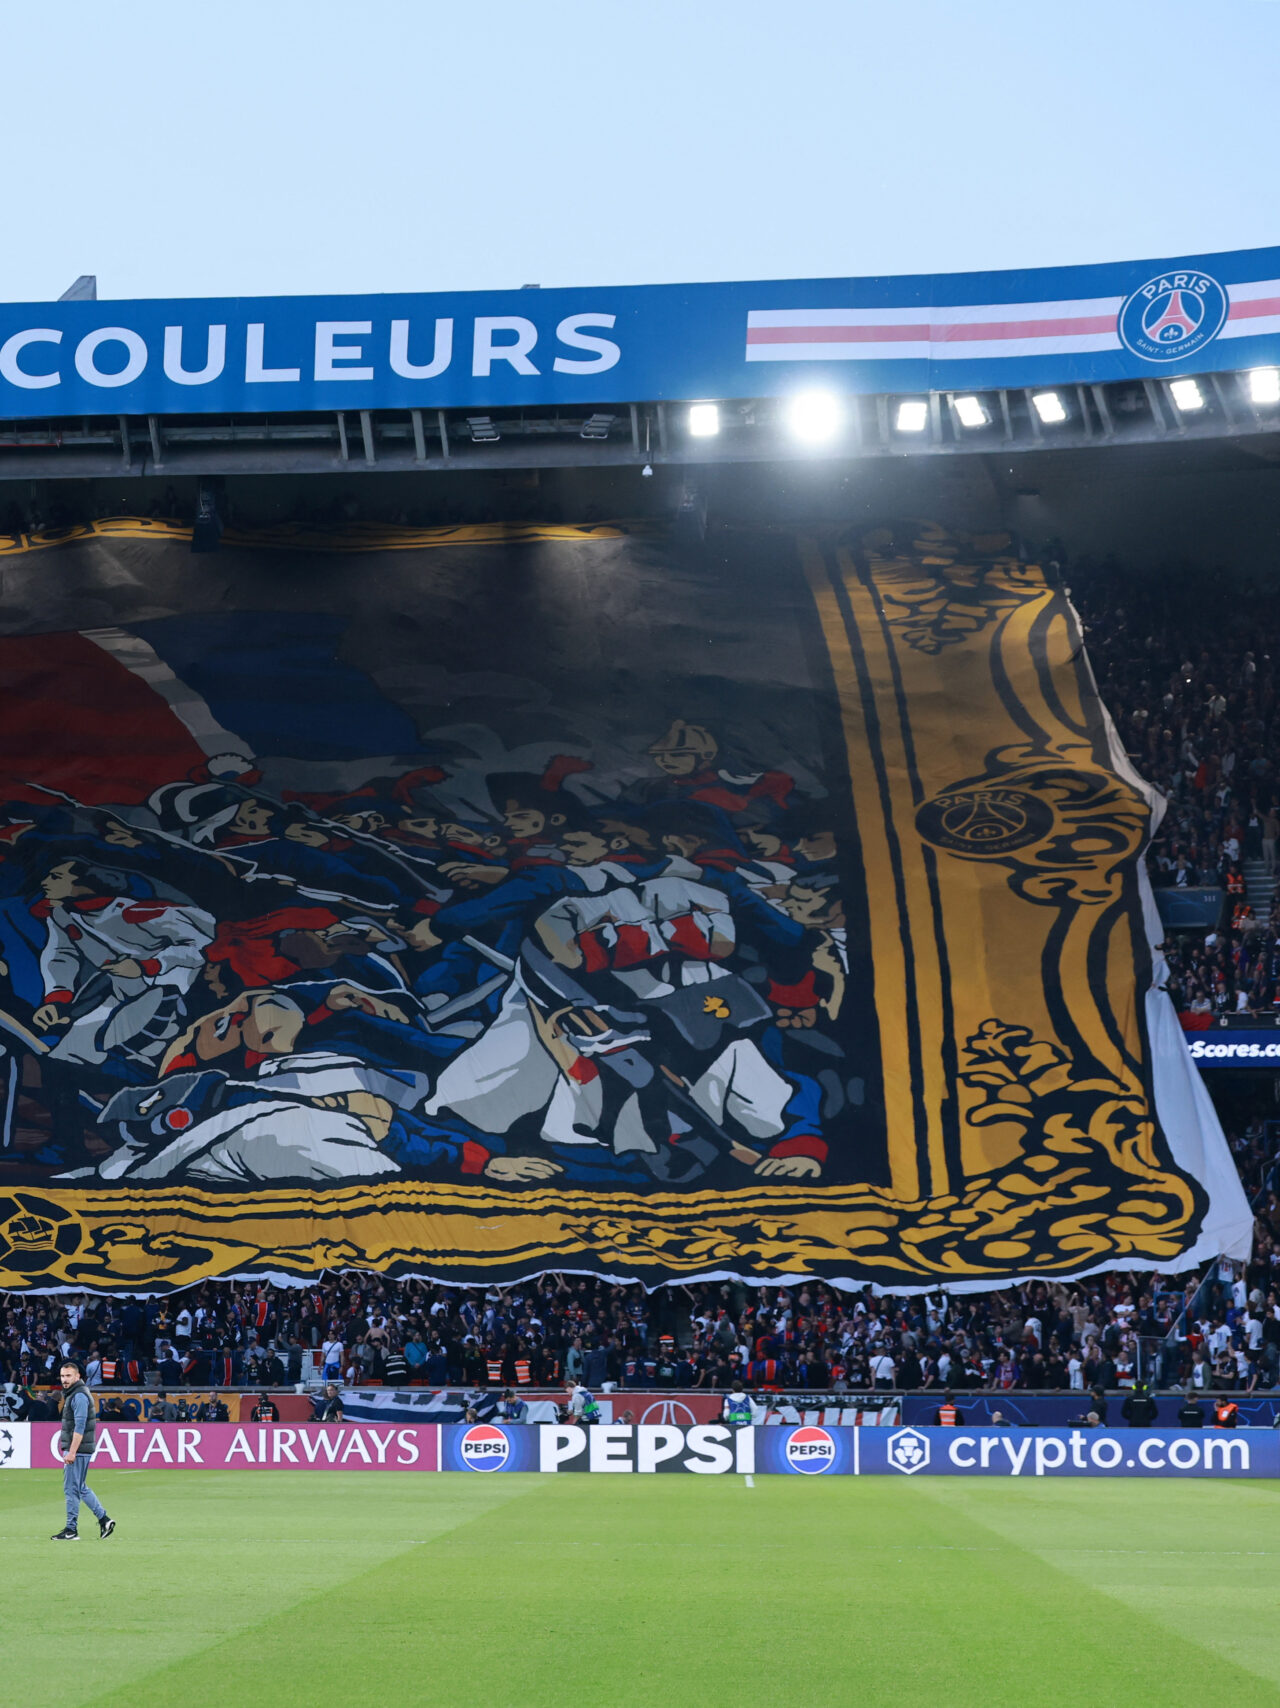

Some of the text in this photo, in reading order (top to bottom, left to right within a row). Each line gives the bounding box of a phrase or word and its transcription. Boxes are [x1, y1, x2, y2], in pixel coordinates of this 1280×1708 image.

[1141, 274, 1211, 300] PARIS
[934, 791, 1026, 809] PARIS
[1188, 1040, 1280, 1058] Scores.c
[224, 1428, 420, 1465] AIRWAYS
[464, 1443, 506, 1454] PEPSI
[539, 1425, 755, 1474] PEPSI
[790, 1445, 831, 1455] PEPSI
[948, 1430, 1250, 1476] crypto.com
